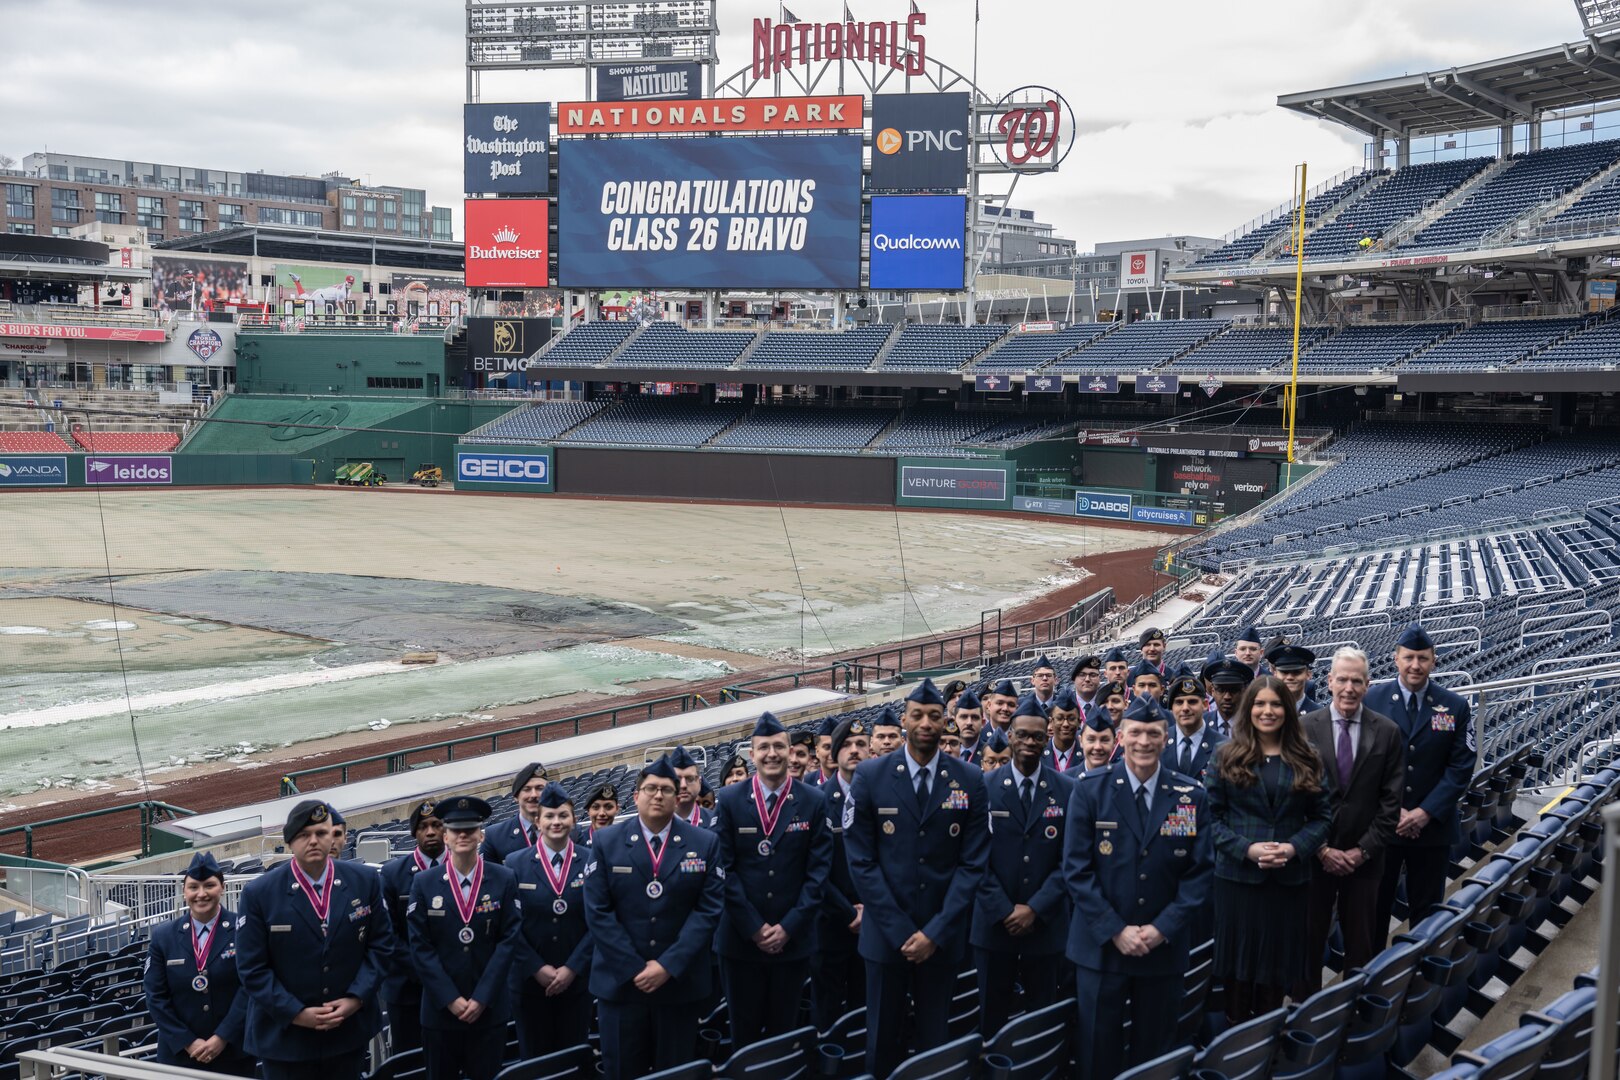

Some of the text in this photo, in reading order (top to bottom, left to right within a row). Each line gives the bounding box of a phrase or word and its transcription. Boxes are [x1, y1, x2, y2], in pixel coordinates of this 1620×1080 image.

[753, 13, 926, 79] NATIONALS
[609, 65, 657, 76] SHOW SOME
[622, 71, 688, 96] NATITUDE
[568, 103, 846, 127] NATIONALS PARK
[493, 115, 519, 134] The
[466, 134, 546, 157] Washington
[905, 129, 963, 152] PNC
[490, 160, 521, 180] Post
[600, 179, 816, 214] CONGRATULATIONS
[607, 216, 808, 251] CLASS 26 BRAVO
[873, 233, 960, 252] Qualcomm
[469, 245, 542, 259] Budweiser
[1227, 268, 1259, 277] ROBINSON
[9, 325, 40, 337] BUD'S
[42, 326, 62, 336] FOR
[64, 327, 88, 338] YOU.
[1103, 437, 1129, 445] NATIONALS
[1147, 446, 1170, 454] NATIONALS
[1190, 456, 1205, 464] The
[12, 465, 62, 474] VANDA
[114, 464, 169, 480] leidos
[461, 459, 546, 479] GEICO
[1182, 464, 1212, 473] network
[1173, 471, 1204, 481] baseball
[908, 477, 999, 490] VENTURE GLOBAL
[1184, 480, 1209, 490] rely on
[1234, 483, 1263, 493] verizon
[1032, 501, 1043, 509] RTX
[1090, 501, 1129, 513] DABOS
[1137, 510, 1178, 521] citycruises
